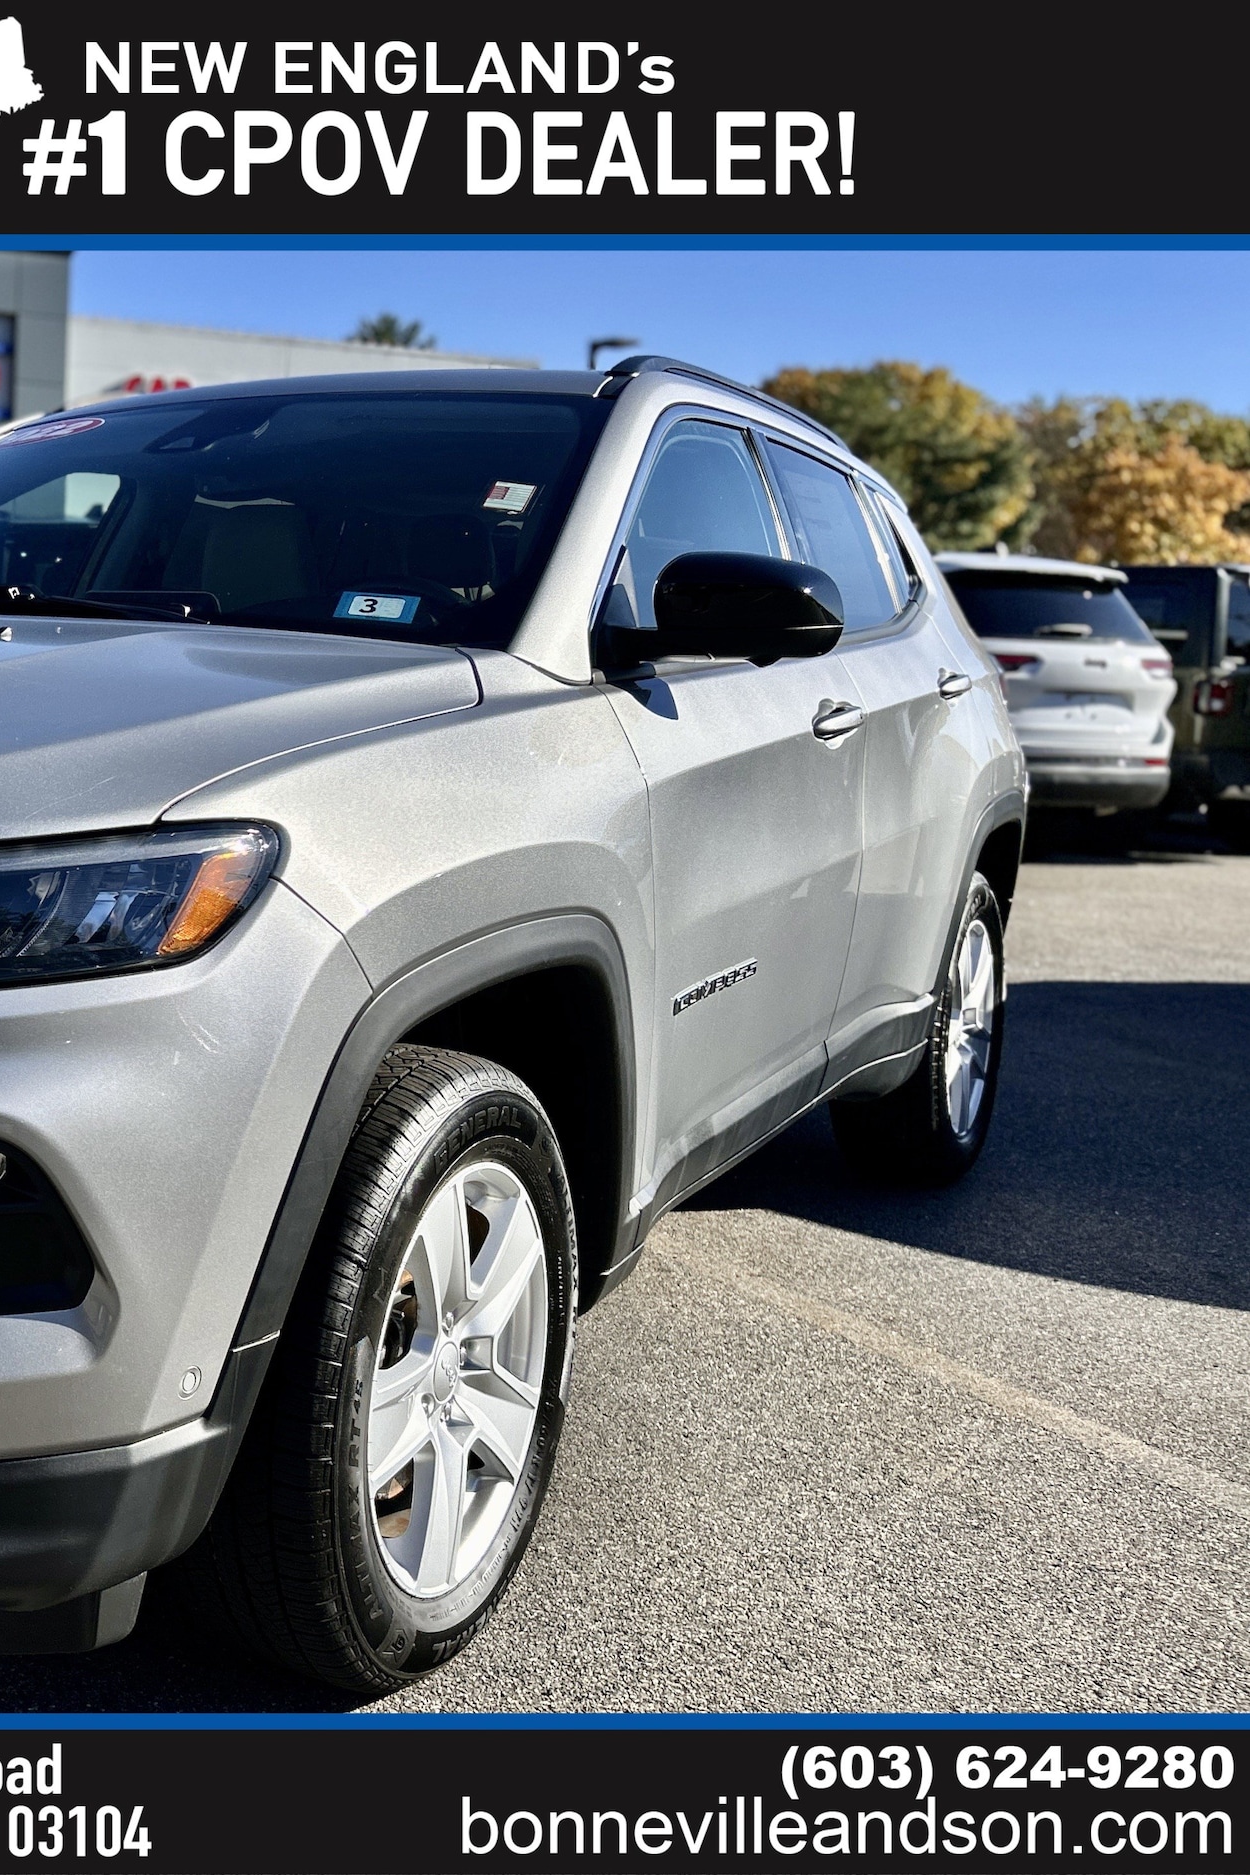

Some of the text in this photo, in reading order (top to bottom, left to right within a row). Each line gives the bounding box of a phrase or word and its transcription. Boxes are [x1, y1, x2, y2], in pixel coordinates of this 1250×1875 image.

[358, 598, 379, 614] 3
[672, 957, 758, 1016] COMPASS
[432, 1104, 522, 1175] GENERAL
